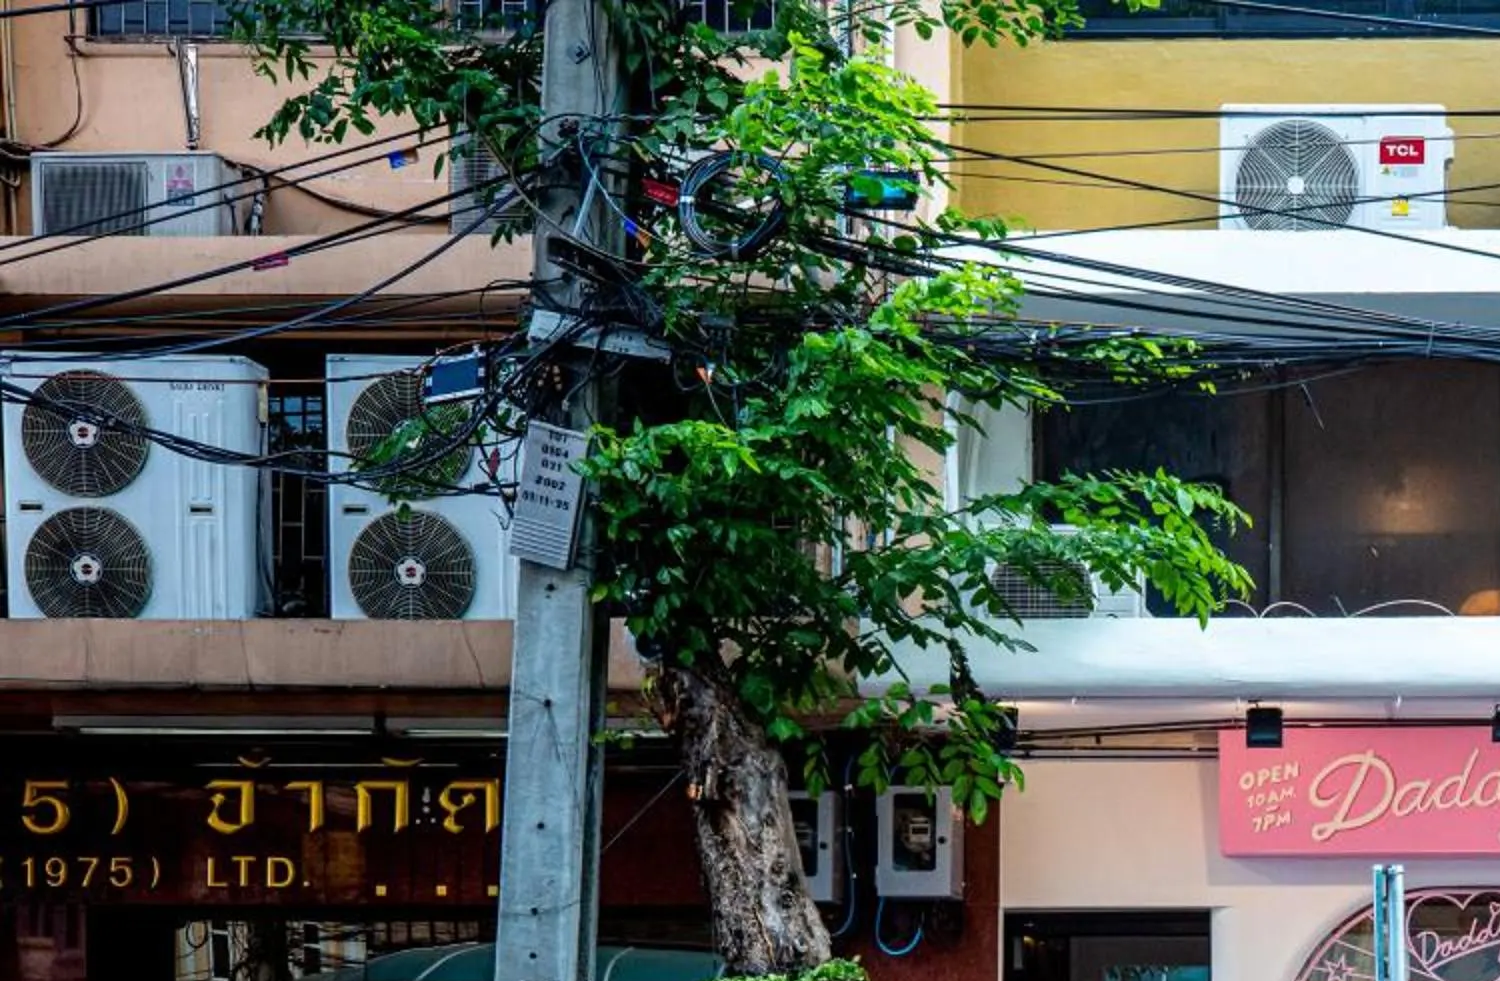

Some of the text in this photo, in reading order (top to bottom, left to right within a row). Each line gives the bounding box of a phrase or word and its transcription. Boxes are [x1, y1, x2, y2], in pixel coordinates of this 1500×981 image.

[1385, 144, 1419, 157] TCL
[1239, 761, 1299, 791] OPEN
[1252, 810, 1292, 833] 7PM
[0, 856, 312, 889] 1975) LTD.
